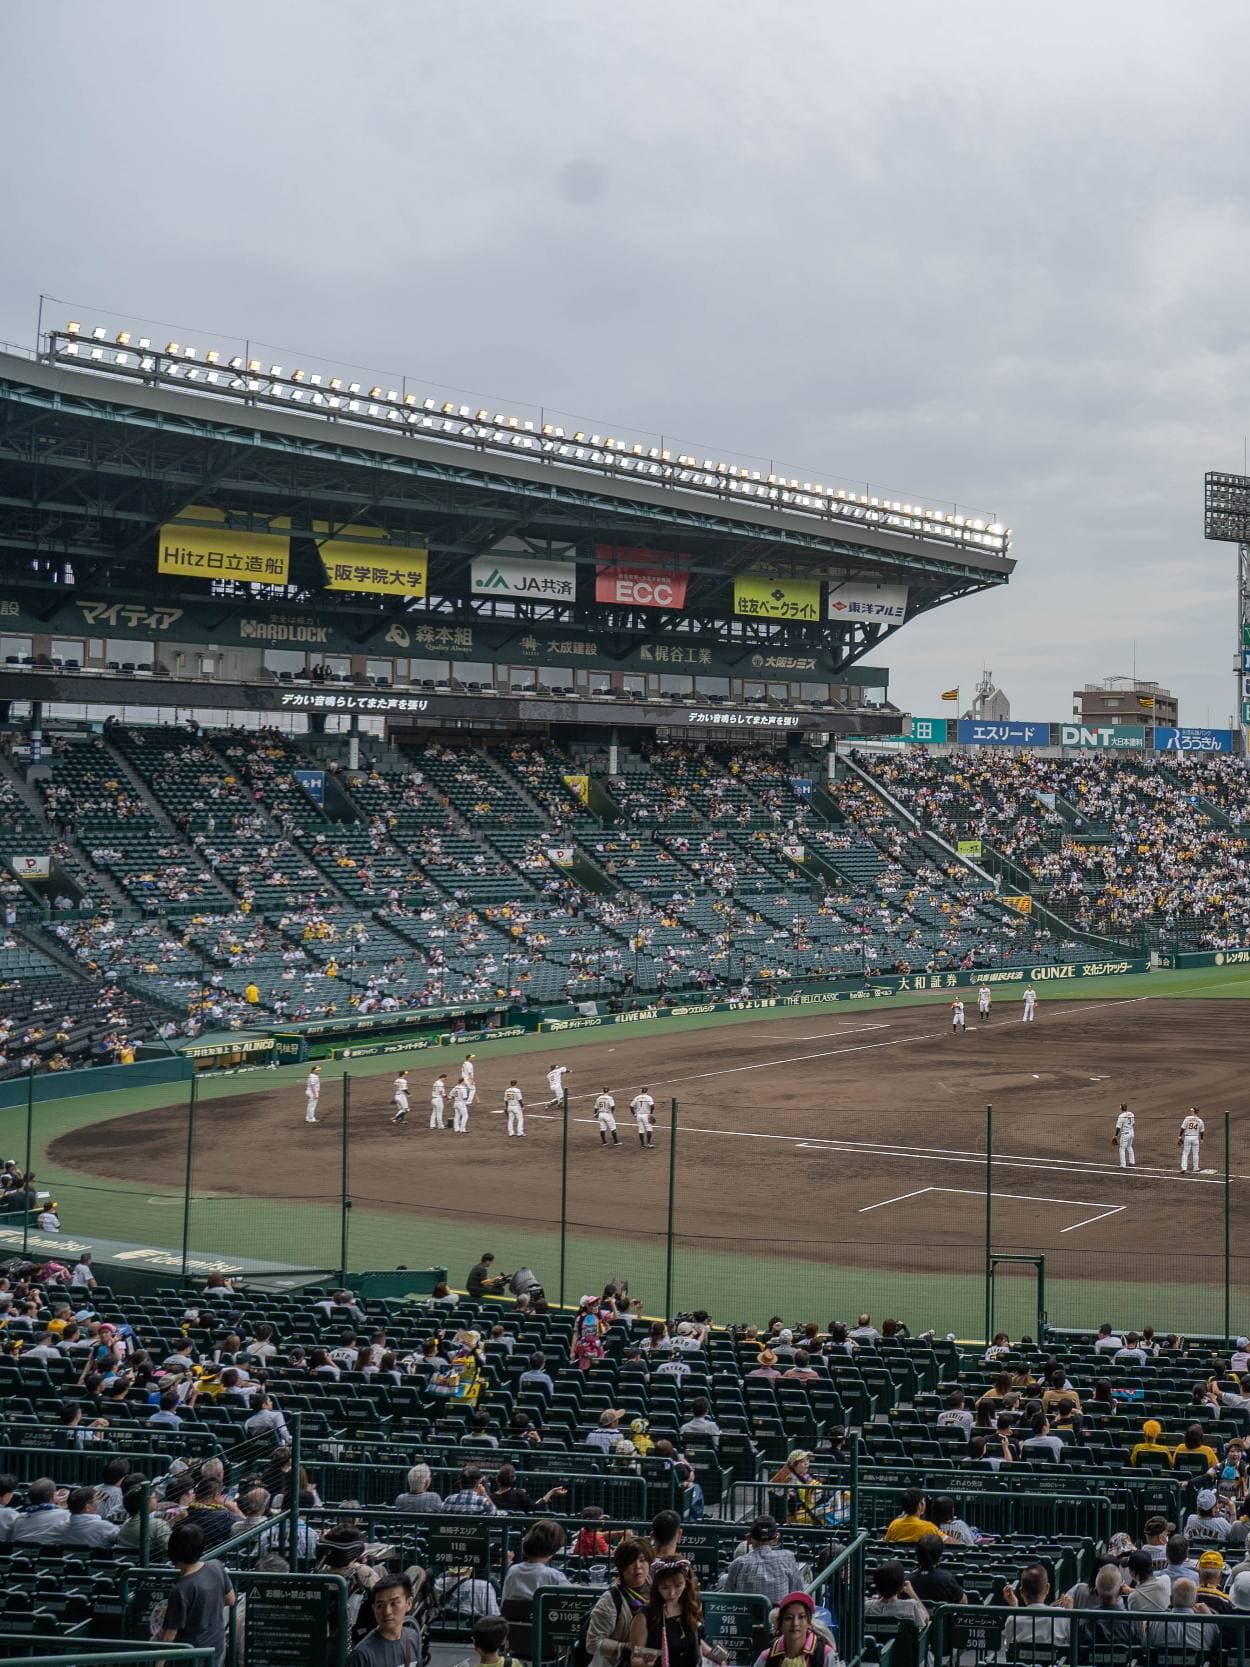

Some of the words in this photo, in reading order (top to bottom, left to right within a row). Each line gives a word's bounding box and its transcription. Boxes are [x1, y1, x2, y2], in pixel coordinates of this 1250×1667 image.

[164, 546, 284, 575] Hitz日立造船
[514, 575, 574, 596] JA共済
[616, 581, 673, 606] ECC
[75, 600, 184, 630] マイティア
[737, 596, 818, 620] 住友ベークライト
[848, 601, 905, 618] 東洋アルミ
[416, 624, 473, 646] 森本組
[547, 642, 598, 656] 大成建設
[655, 644, 713, 664] 梶谷工業
[973, 725, 1035, 743] エスリード
[1062, 727, 1114, 746] DNT
[1110, 737, 1144, 748] 大日本塗料
[1181, 736, 1222, 750] ろうきん
[1031, 966, 1076, 981] GUNZE
[898, 974, 958, 990] 大和証券
[243, 1039, 274, 1052] ALINCO
[451, 1541, 467, 1551] 11段
[678, 1535, 706, 1546] 子エリア
[709, 1603, 749, 1612] アイビーシート
[721, 1615, 736, 1625] 9段
[956, 1615, 997, 1626] アイビーシート
[719, 1625, 738, 1635] 51番
[968, 1628, 986, 1639] 11段
[966, 1639, 987, 1649] 50番
